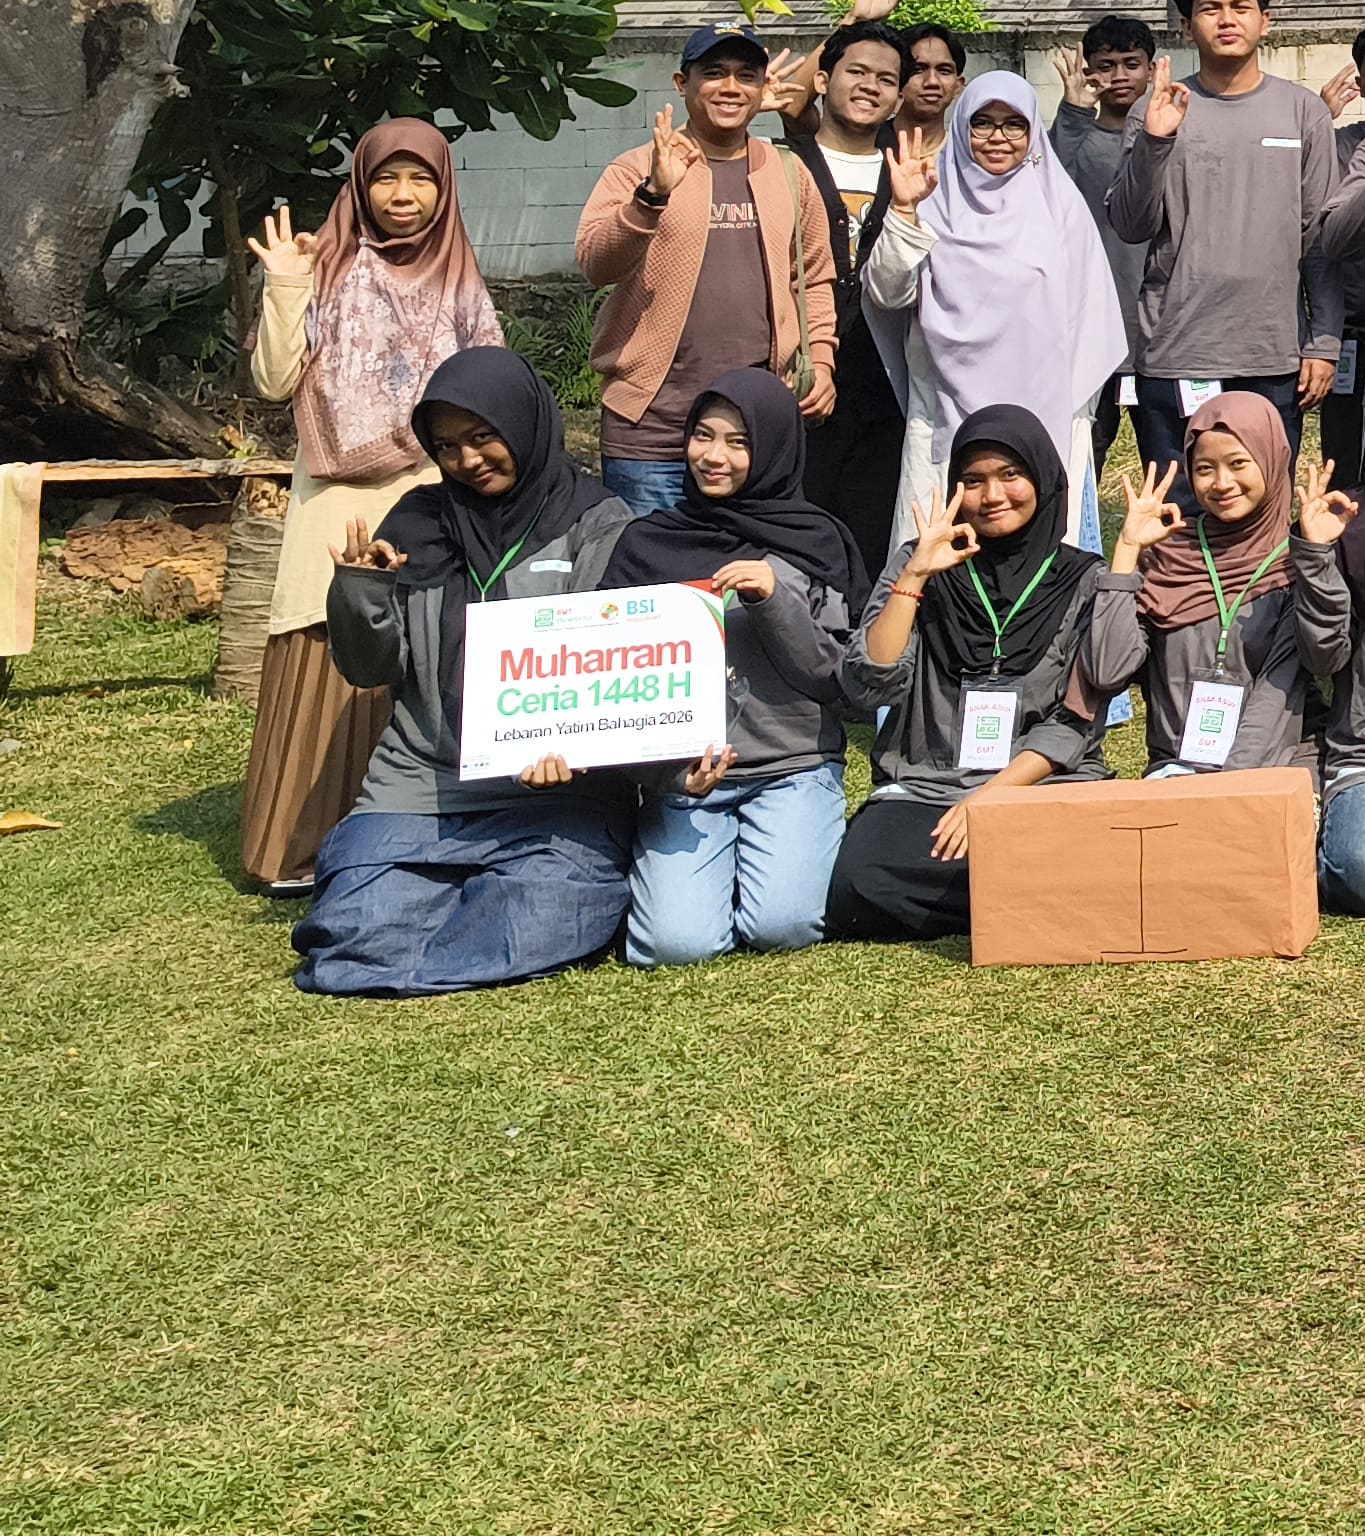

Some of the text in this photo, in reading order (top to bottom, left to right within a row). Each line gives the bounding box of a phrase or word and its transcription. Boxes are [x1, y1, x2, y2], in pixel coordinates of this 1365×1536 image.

[626, 599, 655, 615] BSI
[499, 639, 691, 682] Muharram
[497, 671, 691, 716] Ceria 1448 H
[494, 710, 693, 742] Lebaran Yatim Bahagia 2026
